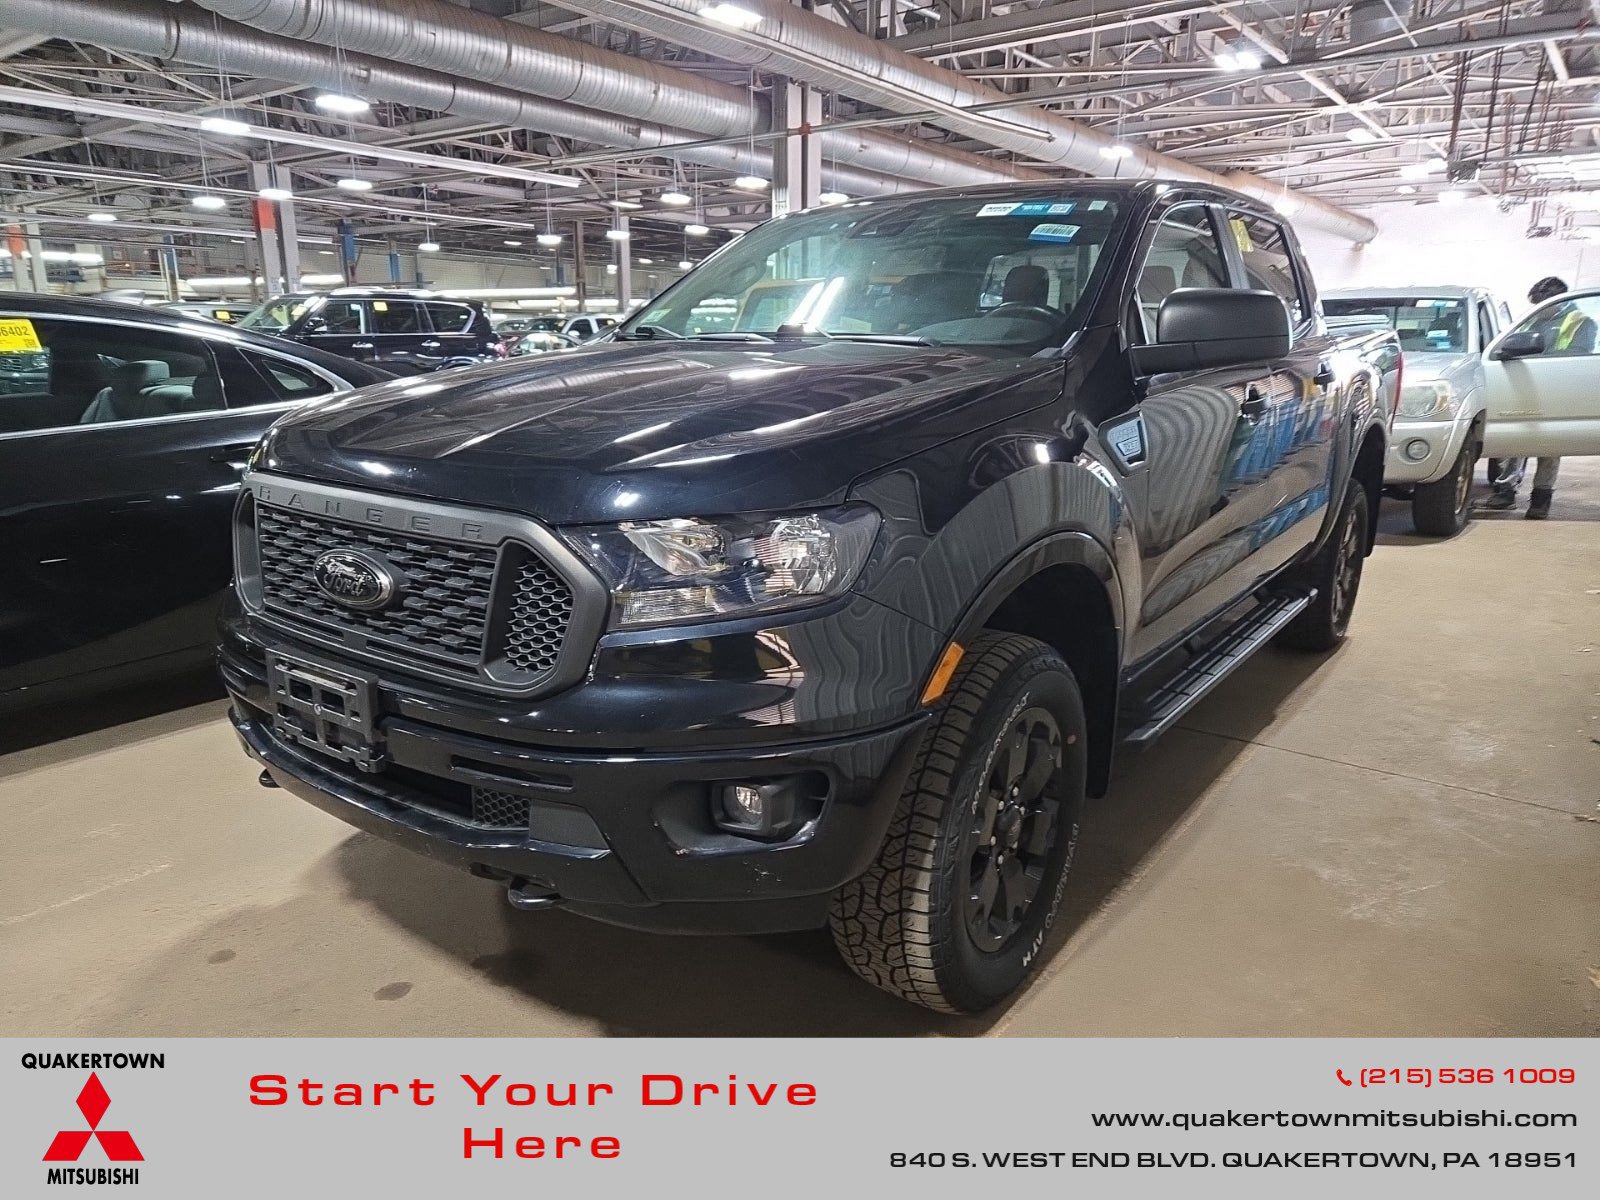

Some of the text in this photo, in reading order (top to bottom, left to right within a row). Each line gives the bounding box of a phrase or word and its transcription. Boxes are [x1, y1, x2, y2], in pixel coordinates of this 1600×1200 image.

[0, 326, 30, 337] 6402
[258, 484, 484, 541] RANGER
[323, 560, 366, 597] Ford
